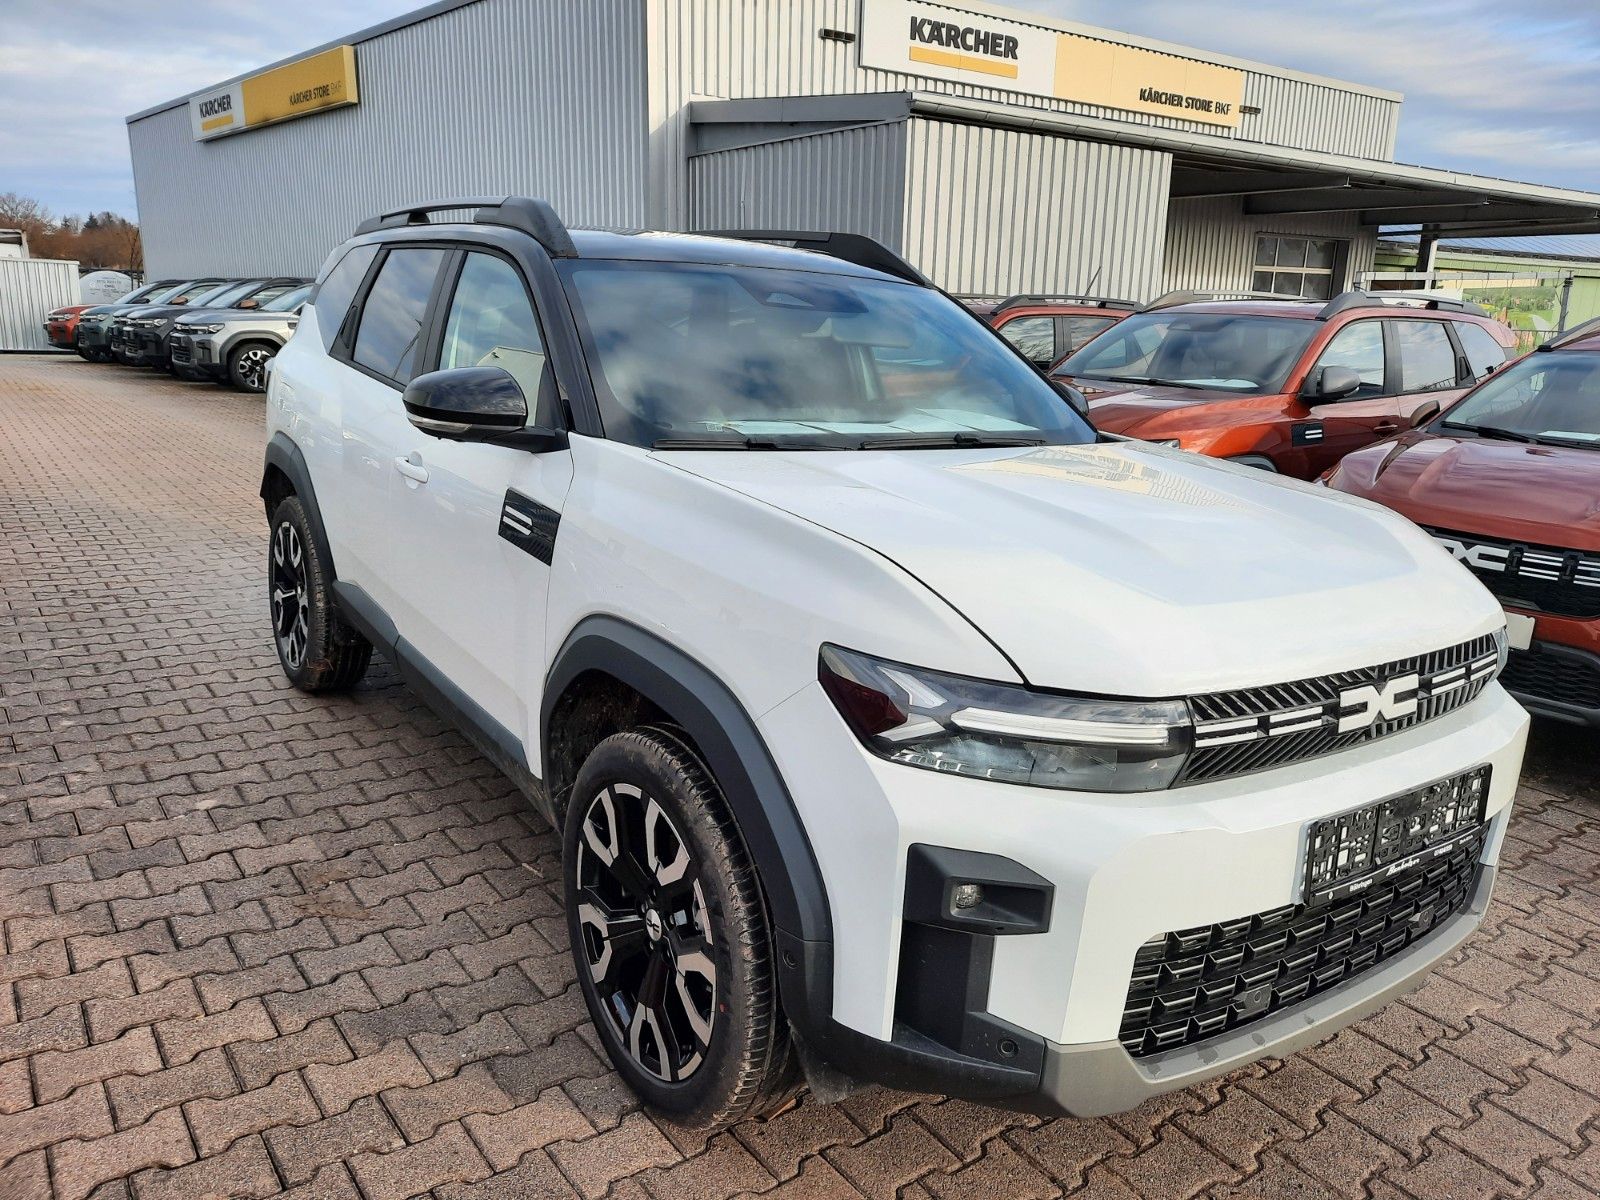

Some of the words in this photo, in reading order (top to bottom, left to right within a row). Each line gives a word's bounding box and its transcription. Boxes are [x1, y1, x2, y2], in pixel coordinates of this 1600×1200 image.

[910, 16, 1018, 60] KÄRCHER
[313, 84, 330, 99] STORE
[1139, 87, 1183, 107] KÄRCHER
[1185, 96, 1213, 113] STORE
[1214, 101, 1232, 115] BKF
[199, 93, 232, 118] KÄRCHER
